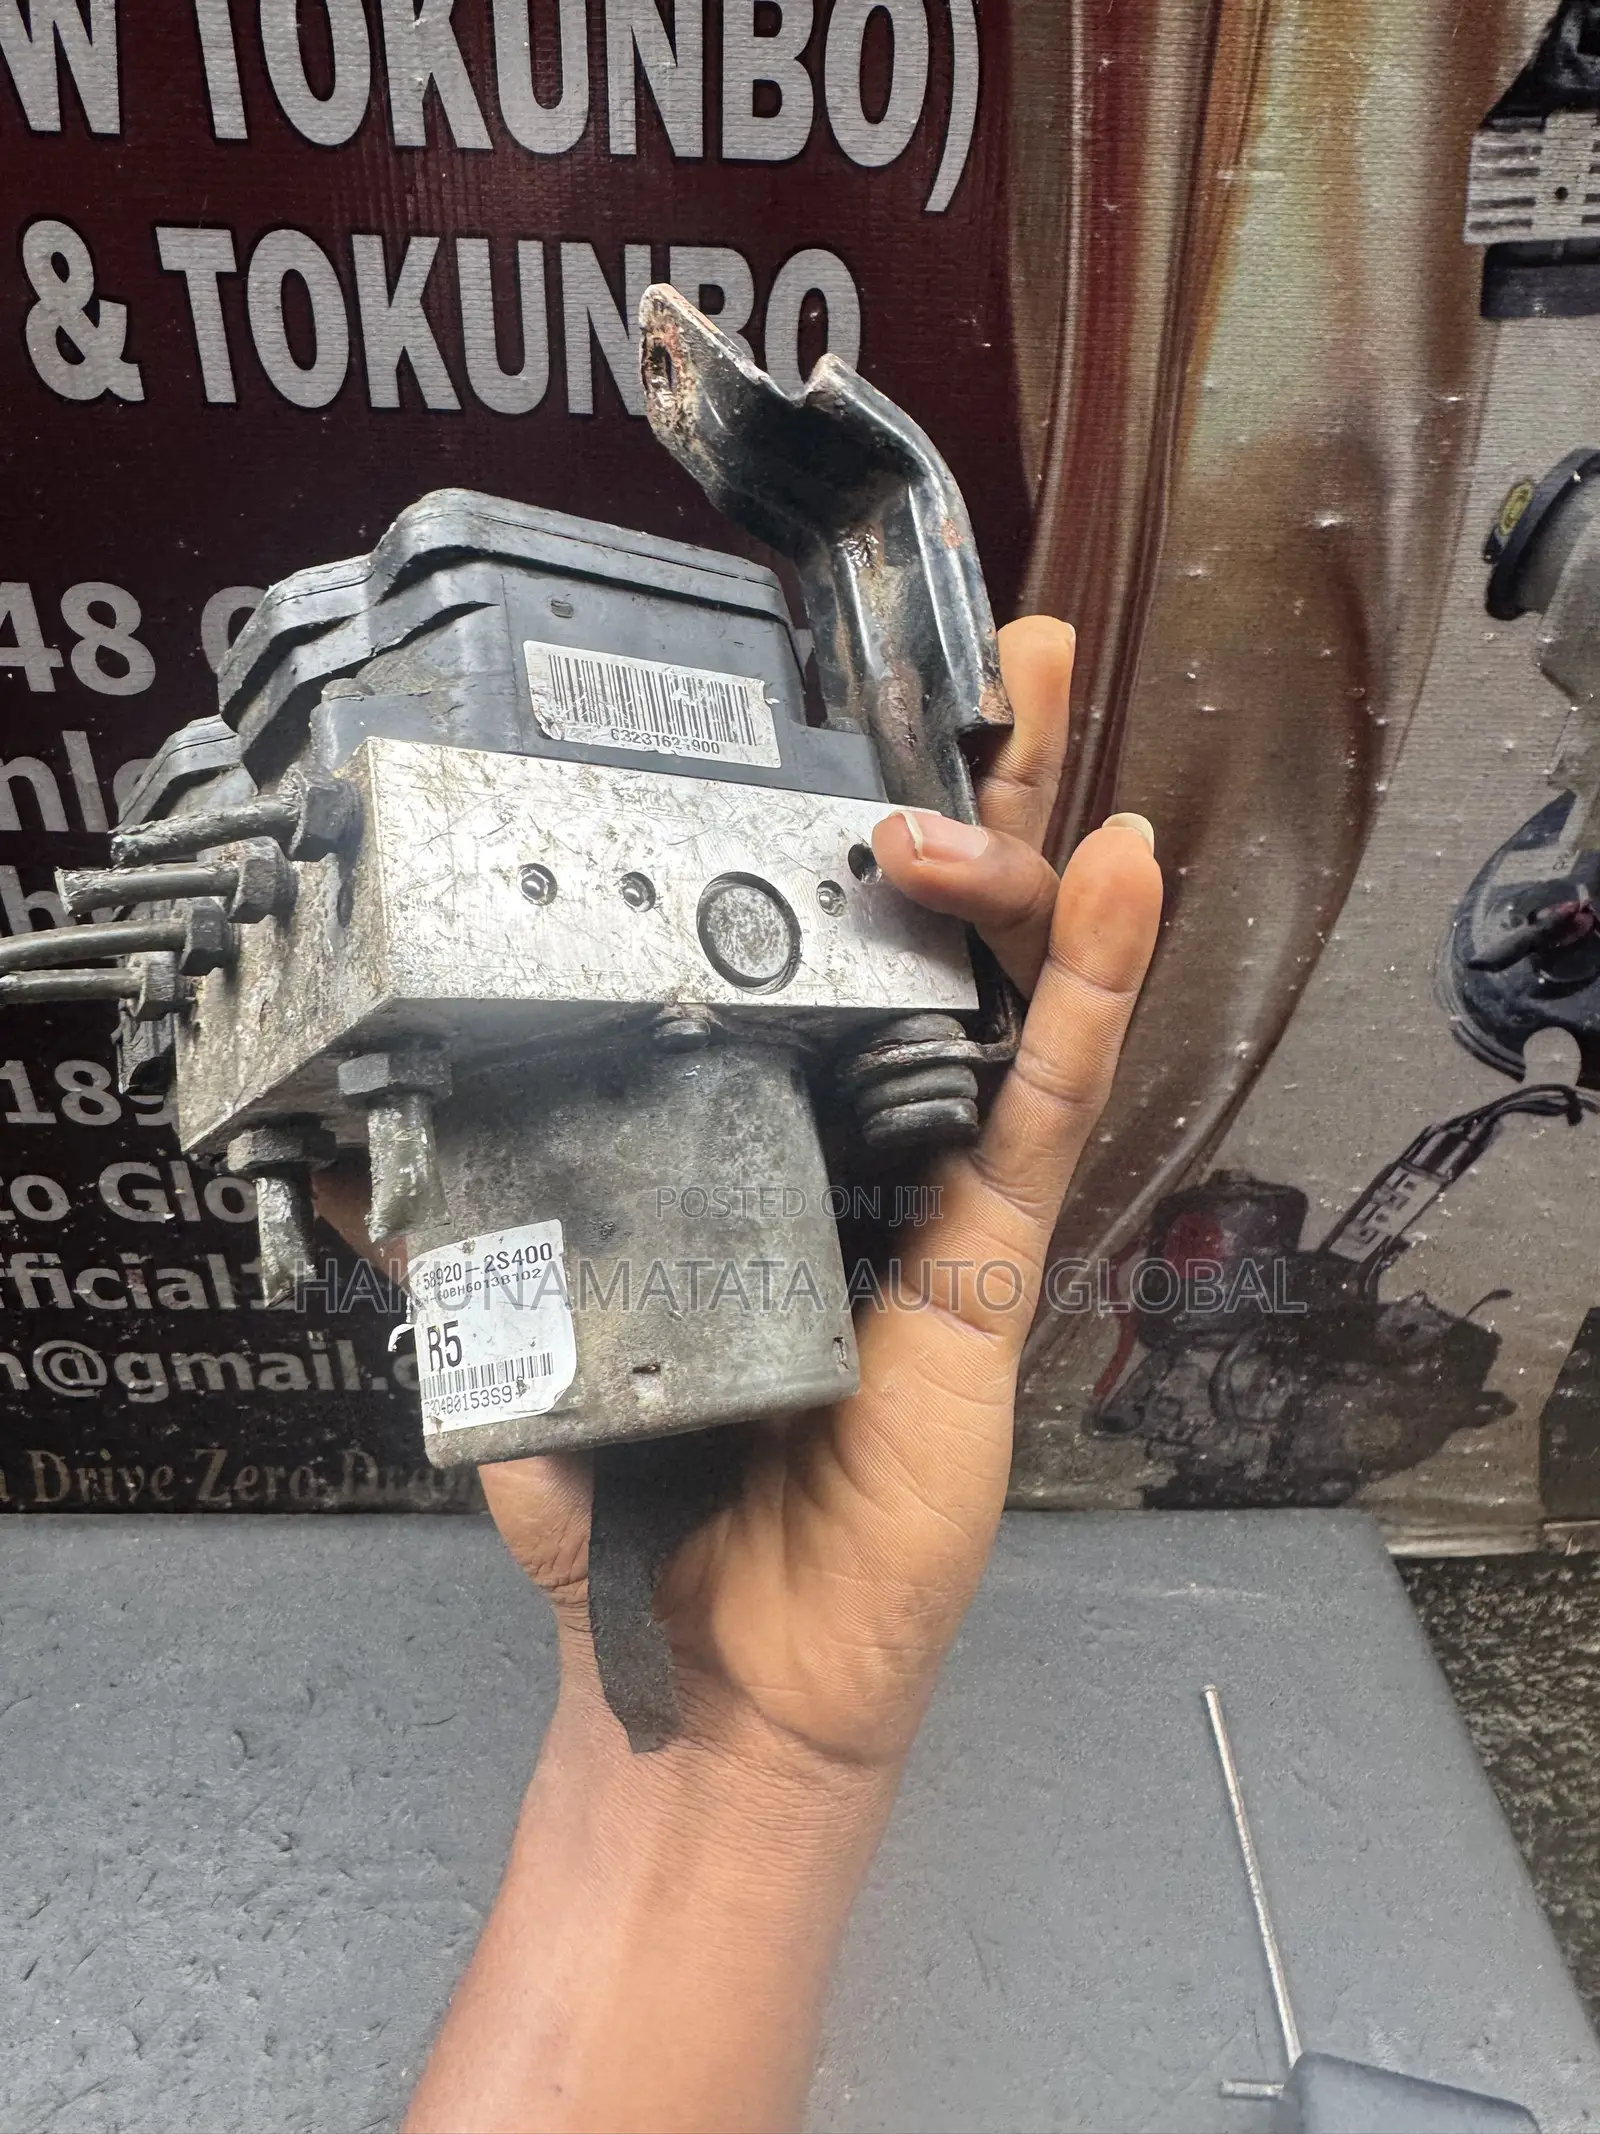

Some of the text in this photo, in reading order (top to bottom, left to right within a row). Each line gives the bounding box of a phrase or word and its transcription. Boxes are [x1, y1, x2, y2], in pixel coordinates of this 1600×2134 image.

[22, 219, 145, 402] &
[427, 1320, 463, 1372] R5
[26, 1447, 174, 1505] Drive
[194, 1447, 318, 1505] Zero
